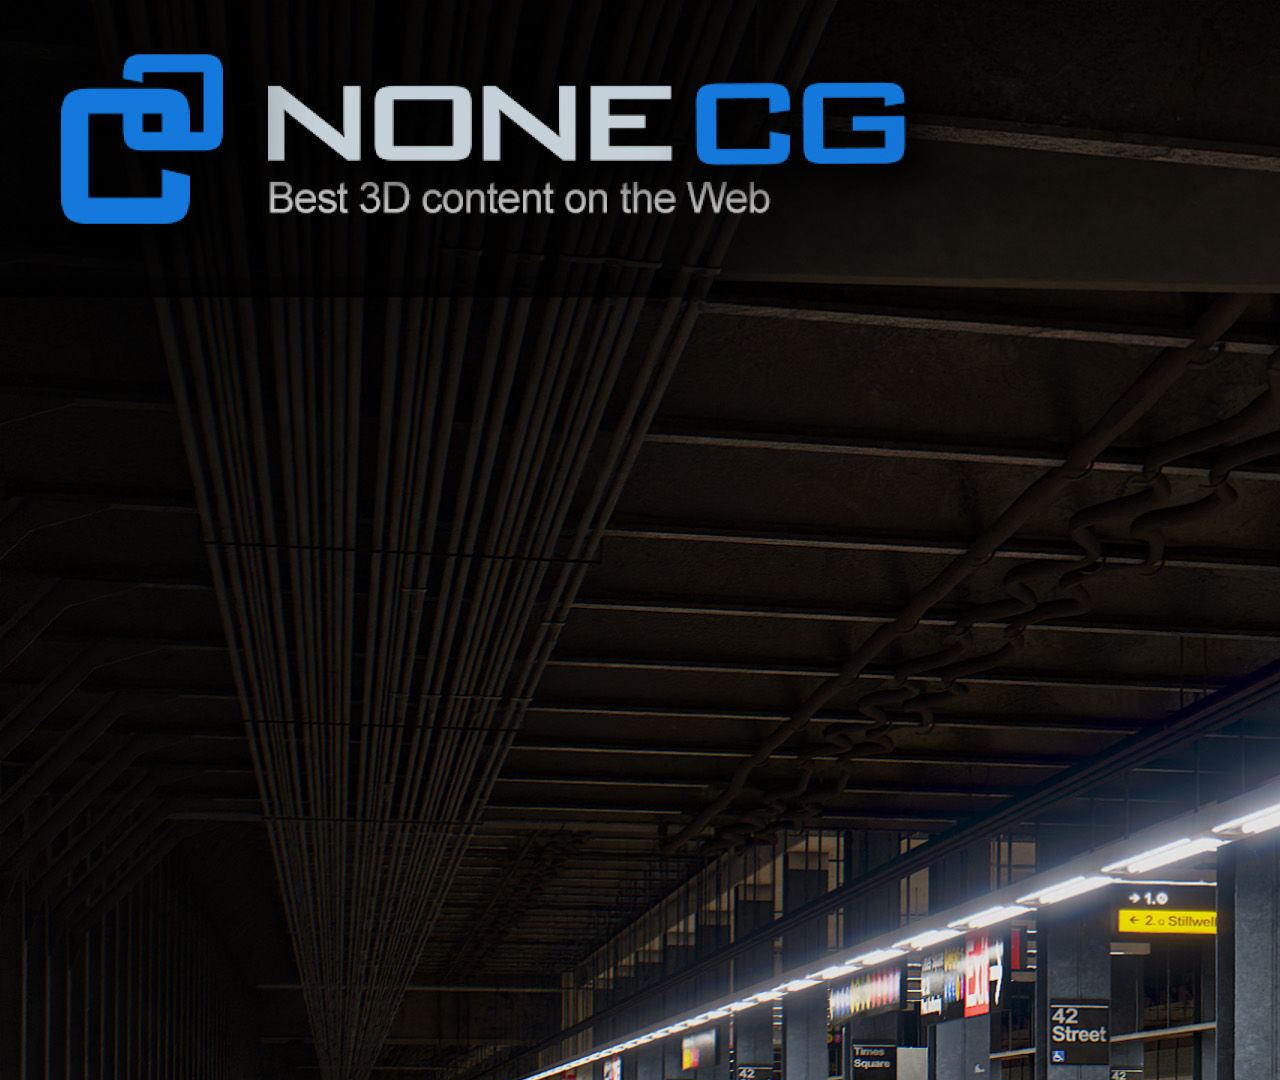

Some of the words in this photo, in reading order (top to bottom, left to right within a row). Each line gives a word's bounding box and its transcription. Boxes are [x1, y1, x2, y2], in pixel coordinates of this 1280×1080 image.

[1051, 1007, 1079, 1025] 42
[1051, 1025, 1108, 1043] Street
[854, 1047, 886, 1057] Times
[853, 1058, 891, 1070] Square
[738, 1068, 756, 1079] 42
